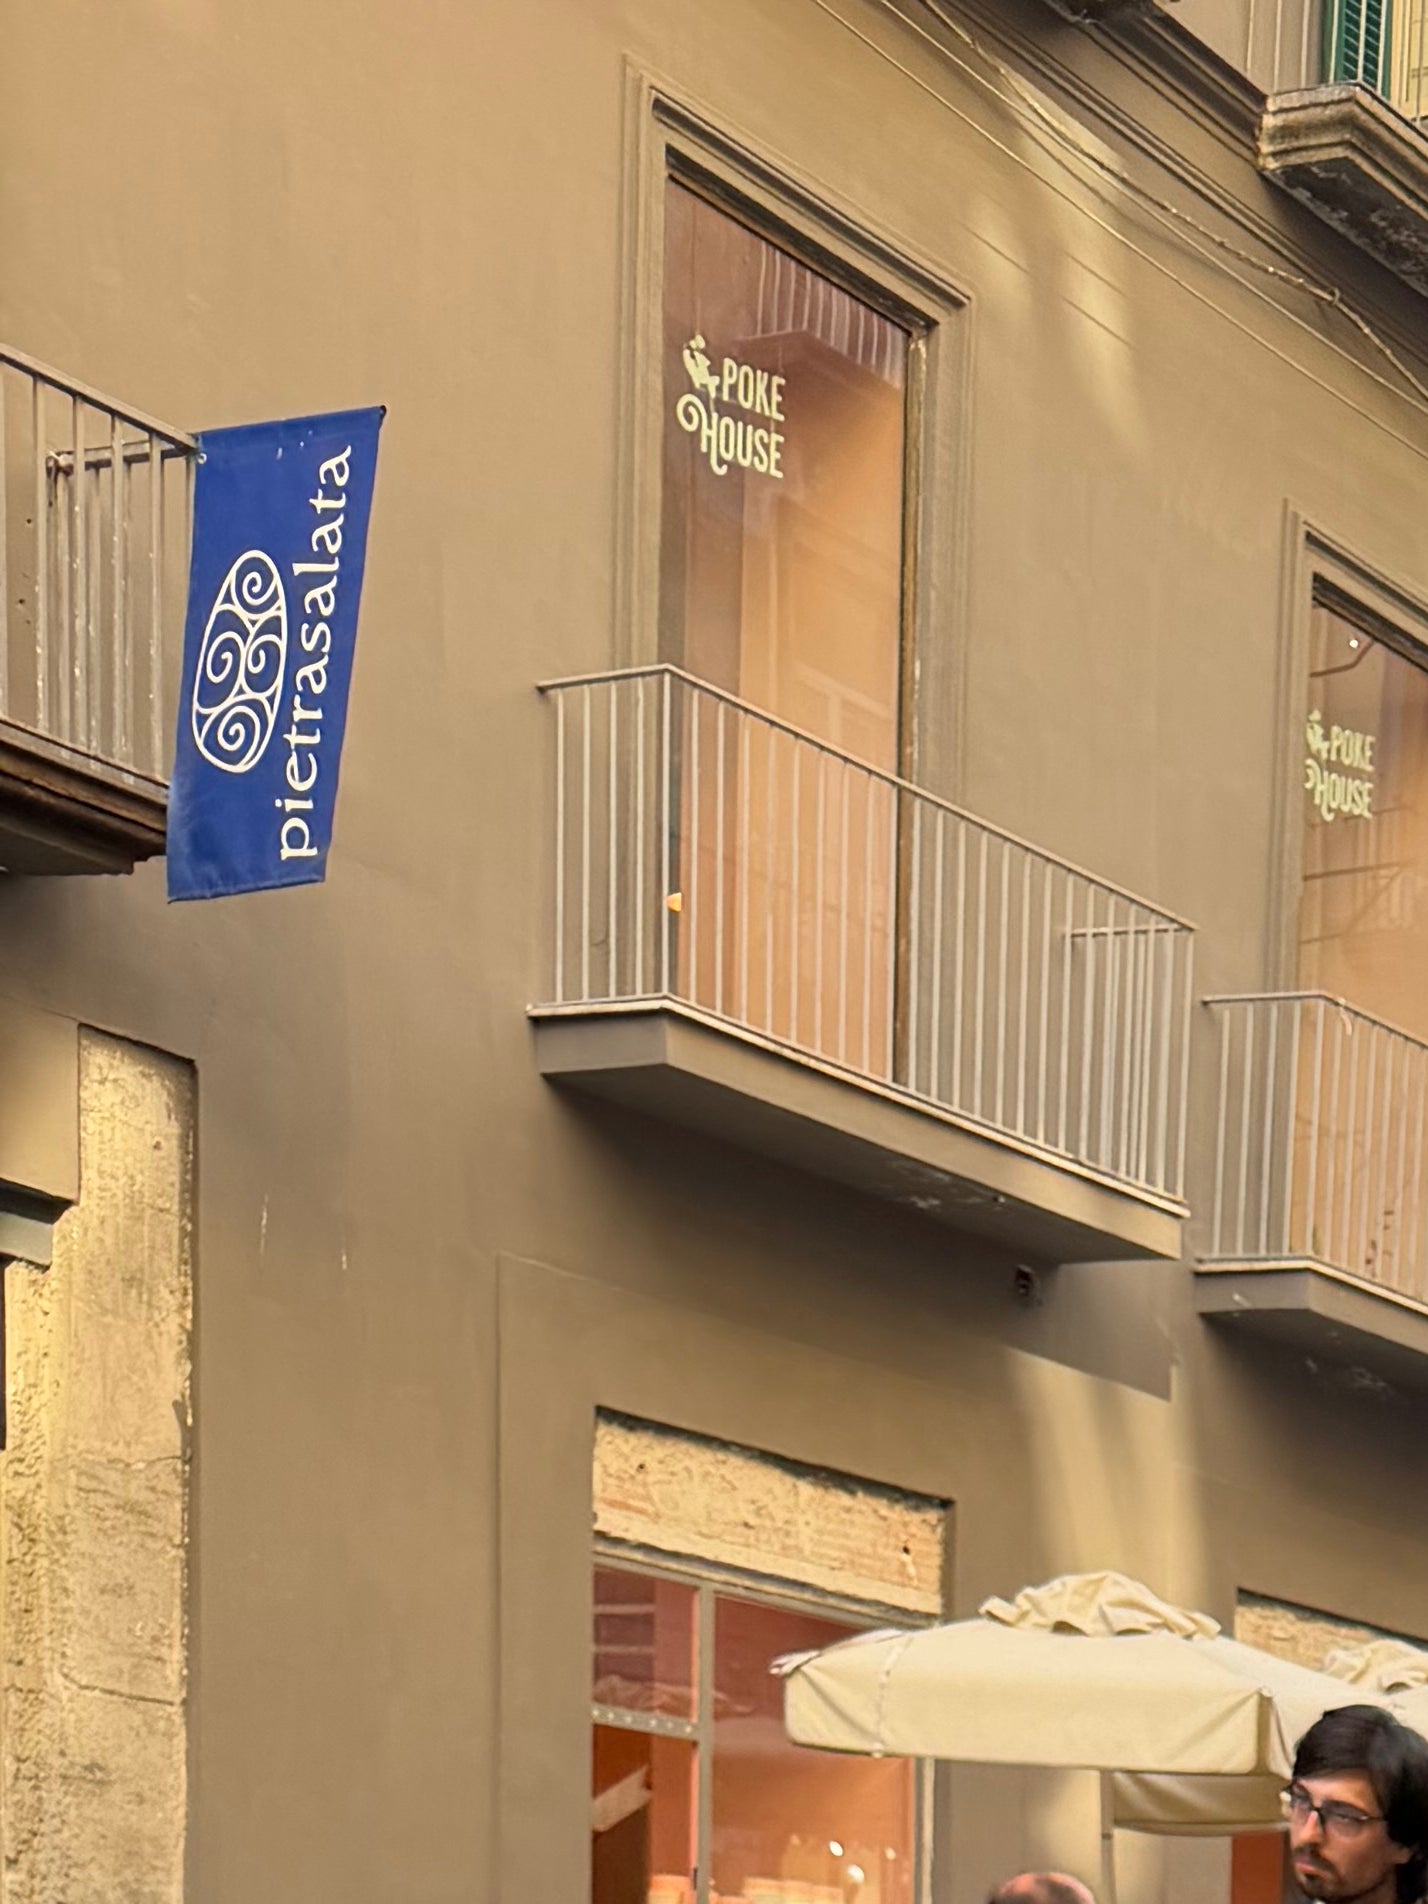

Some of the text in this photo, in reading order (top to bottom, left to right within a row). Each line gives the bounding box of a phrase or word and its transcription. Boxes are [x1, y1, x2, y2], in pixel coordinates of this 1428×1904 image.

[722, 357, 786, 422] POKE
[676, 393, 785, 479] HOUSE
[274, 445, 352, 862] pietrasalata
[1330, 724, 1376, 772] POKE
[1304, 758, 1374, 822] HOUSE
